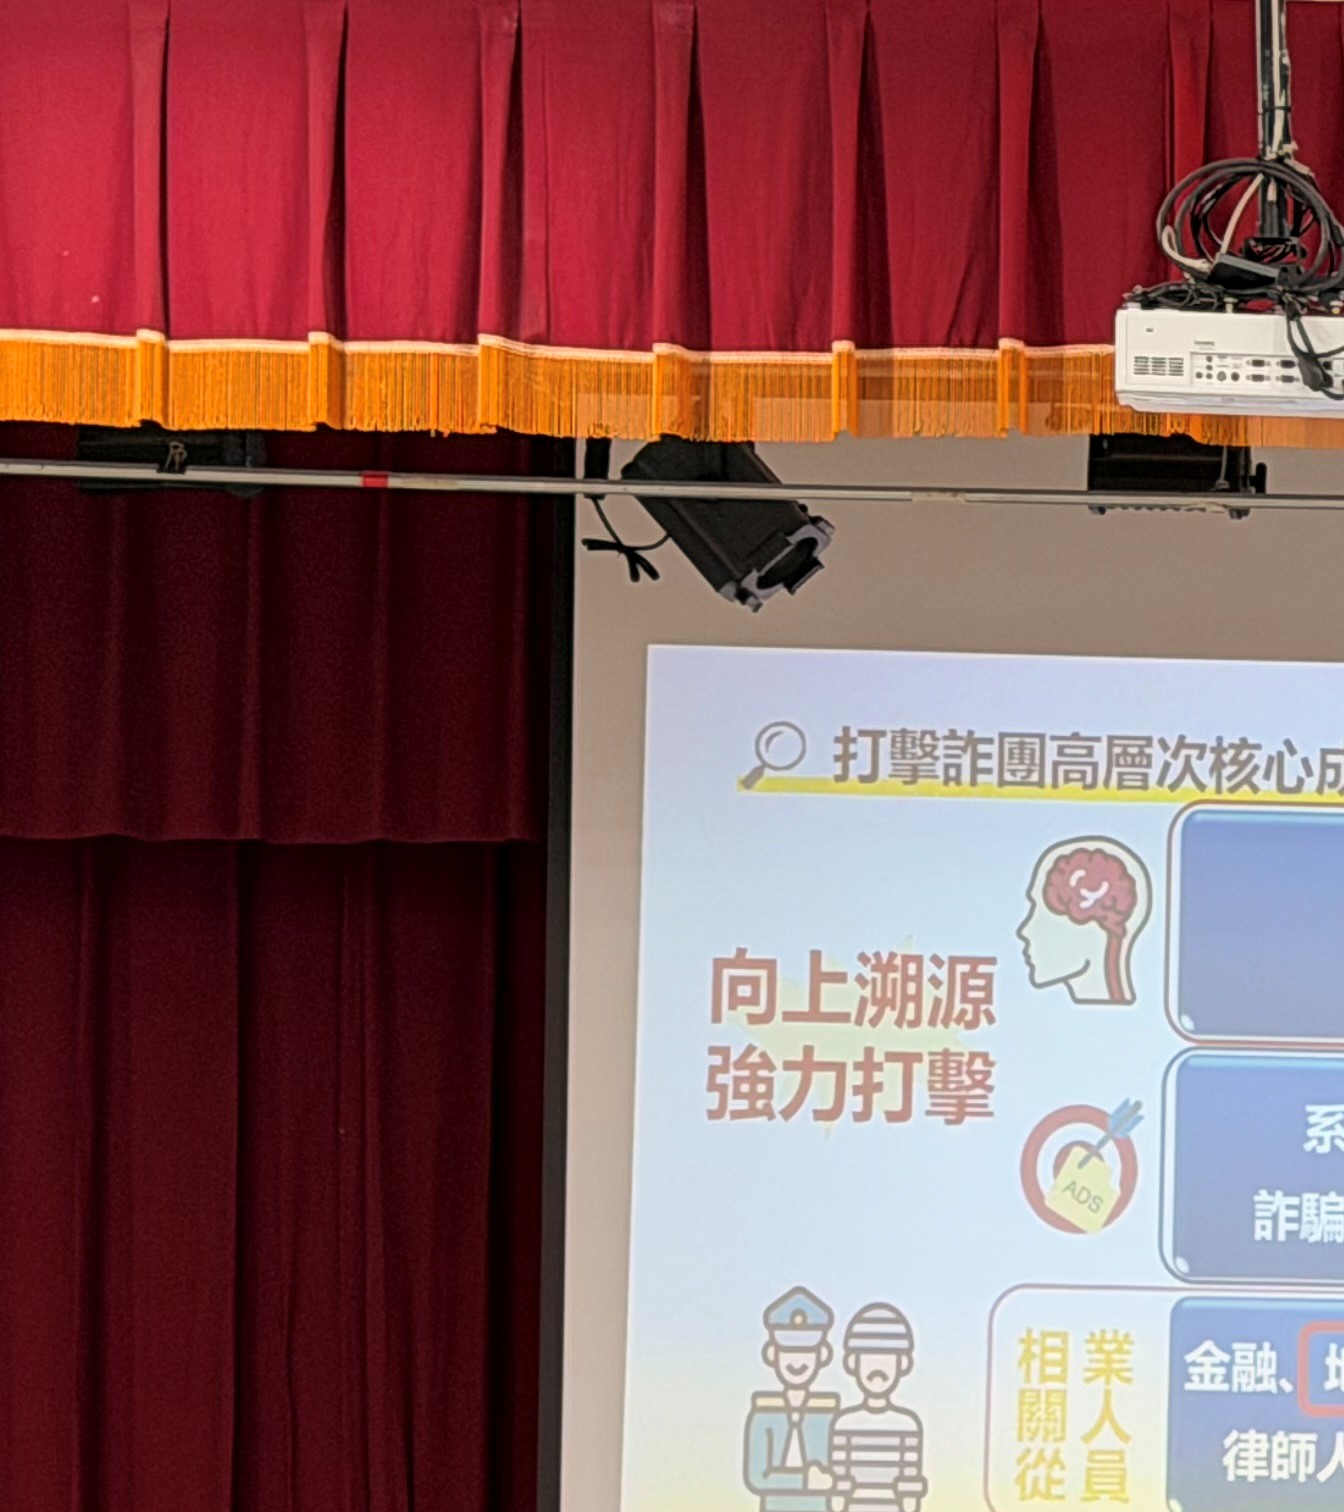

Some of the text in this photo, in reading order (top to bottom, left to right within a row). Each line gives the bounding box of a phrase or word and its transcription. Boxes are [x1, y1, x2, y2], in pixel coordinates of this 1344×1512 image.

[711, 947, 998, 1029] 向上溯源
[705, 1044, 995, 1126] 強力打擊
[1062, 1180, 1104, 1213] ADS
